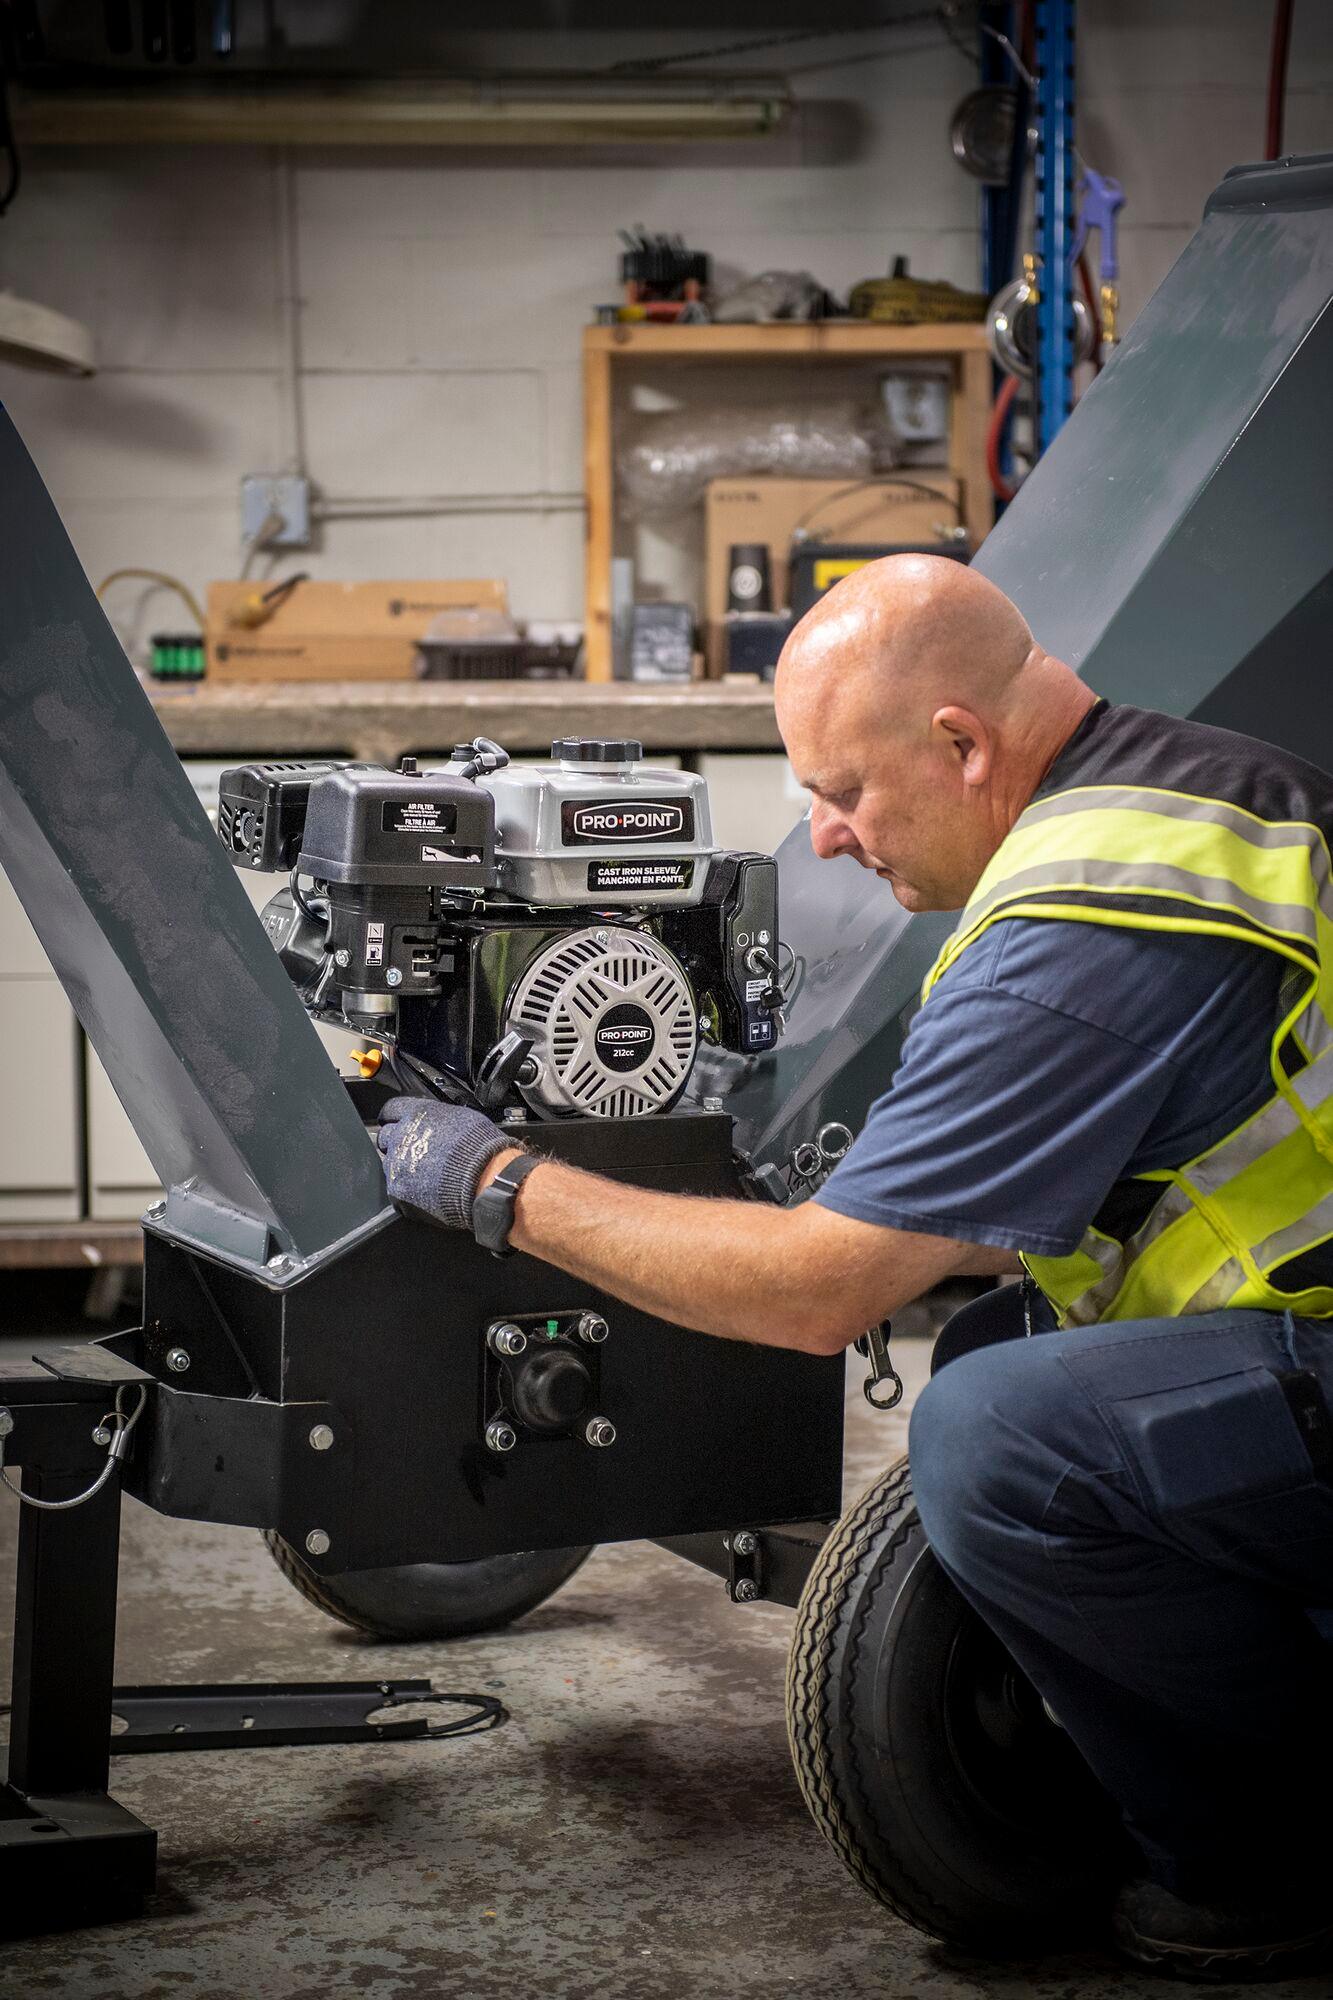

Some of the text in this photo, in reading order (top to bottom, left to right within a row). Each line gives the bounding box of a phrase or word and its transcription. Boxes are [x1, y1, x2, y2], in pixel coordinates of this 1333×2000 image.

[597, 866, 681, 876] CAST IRON SLEEVE/
[597, 875, 684, 885] MANCHON EN FONTE
[613, 1049, 635, 1057] 212cc
